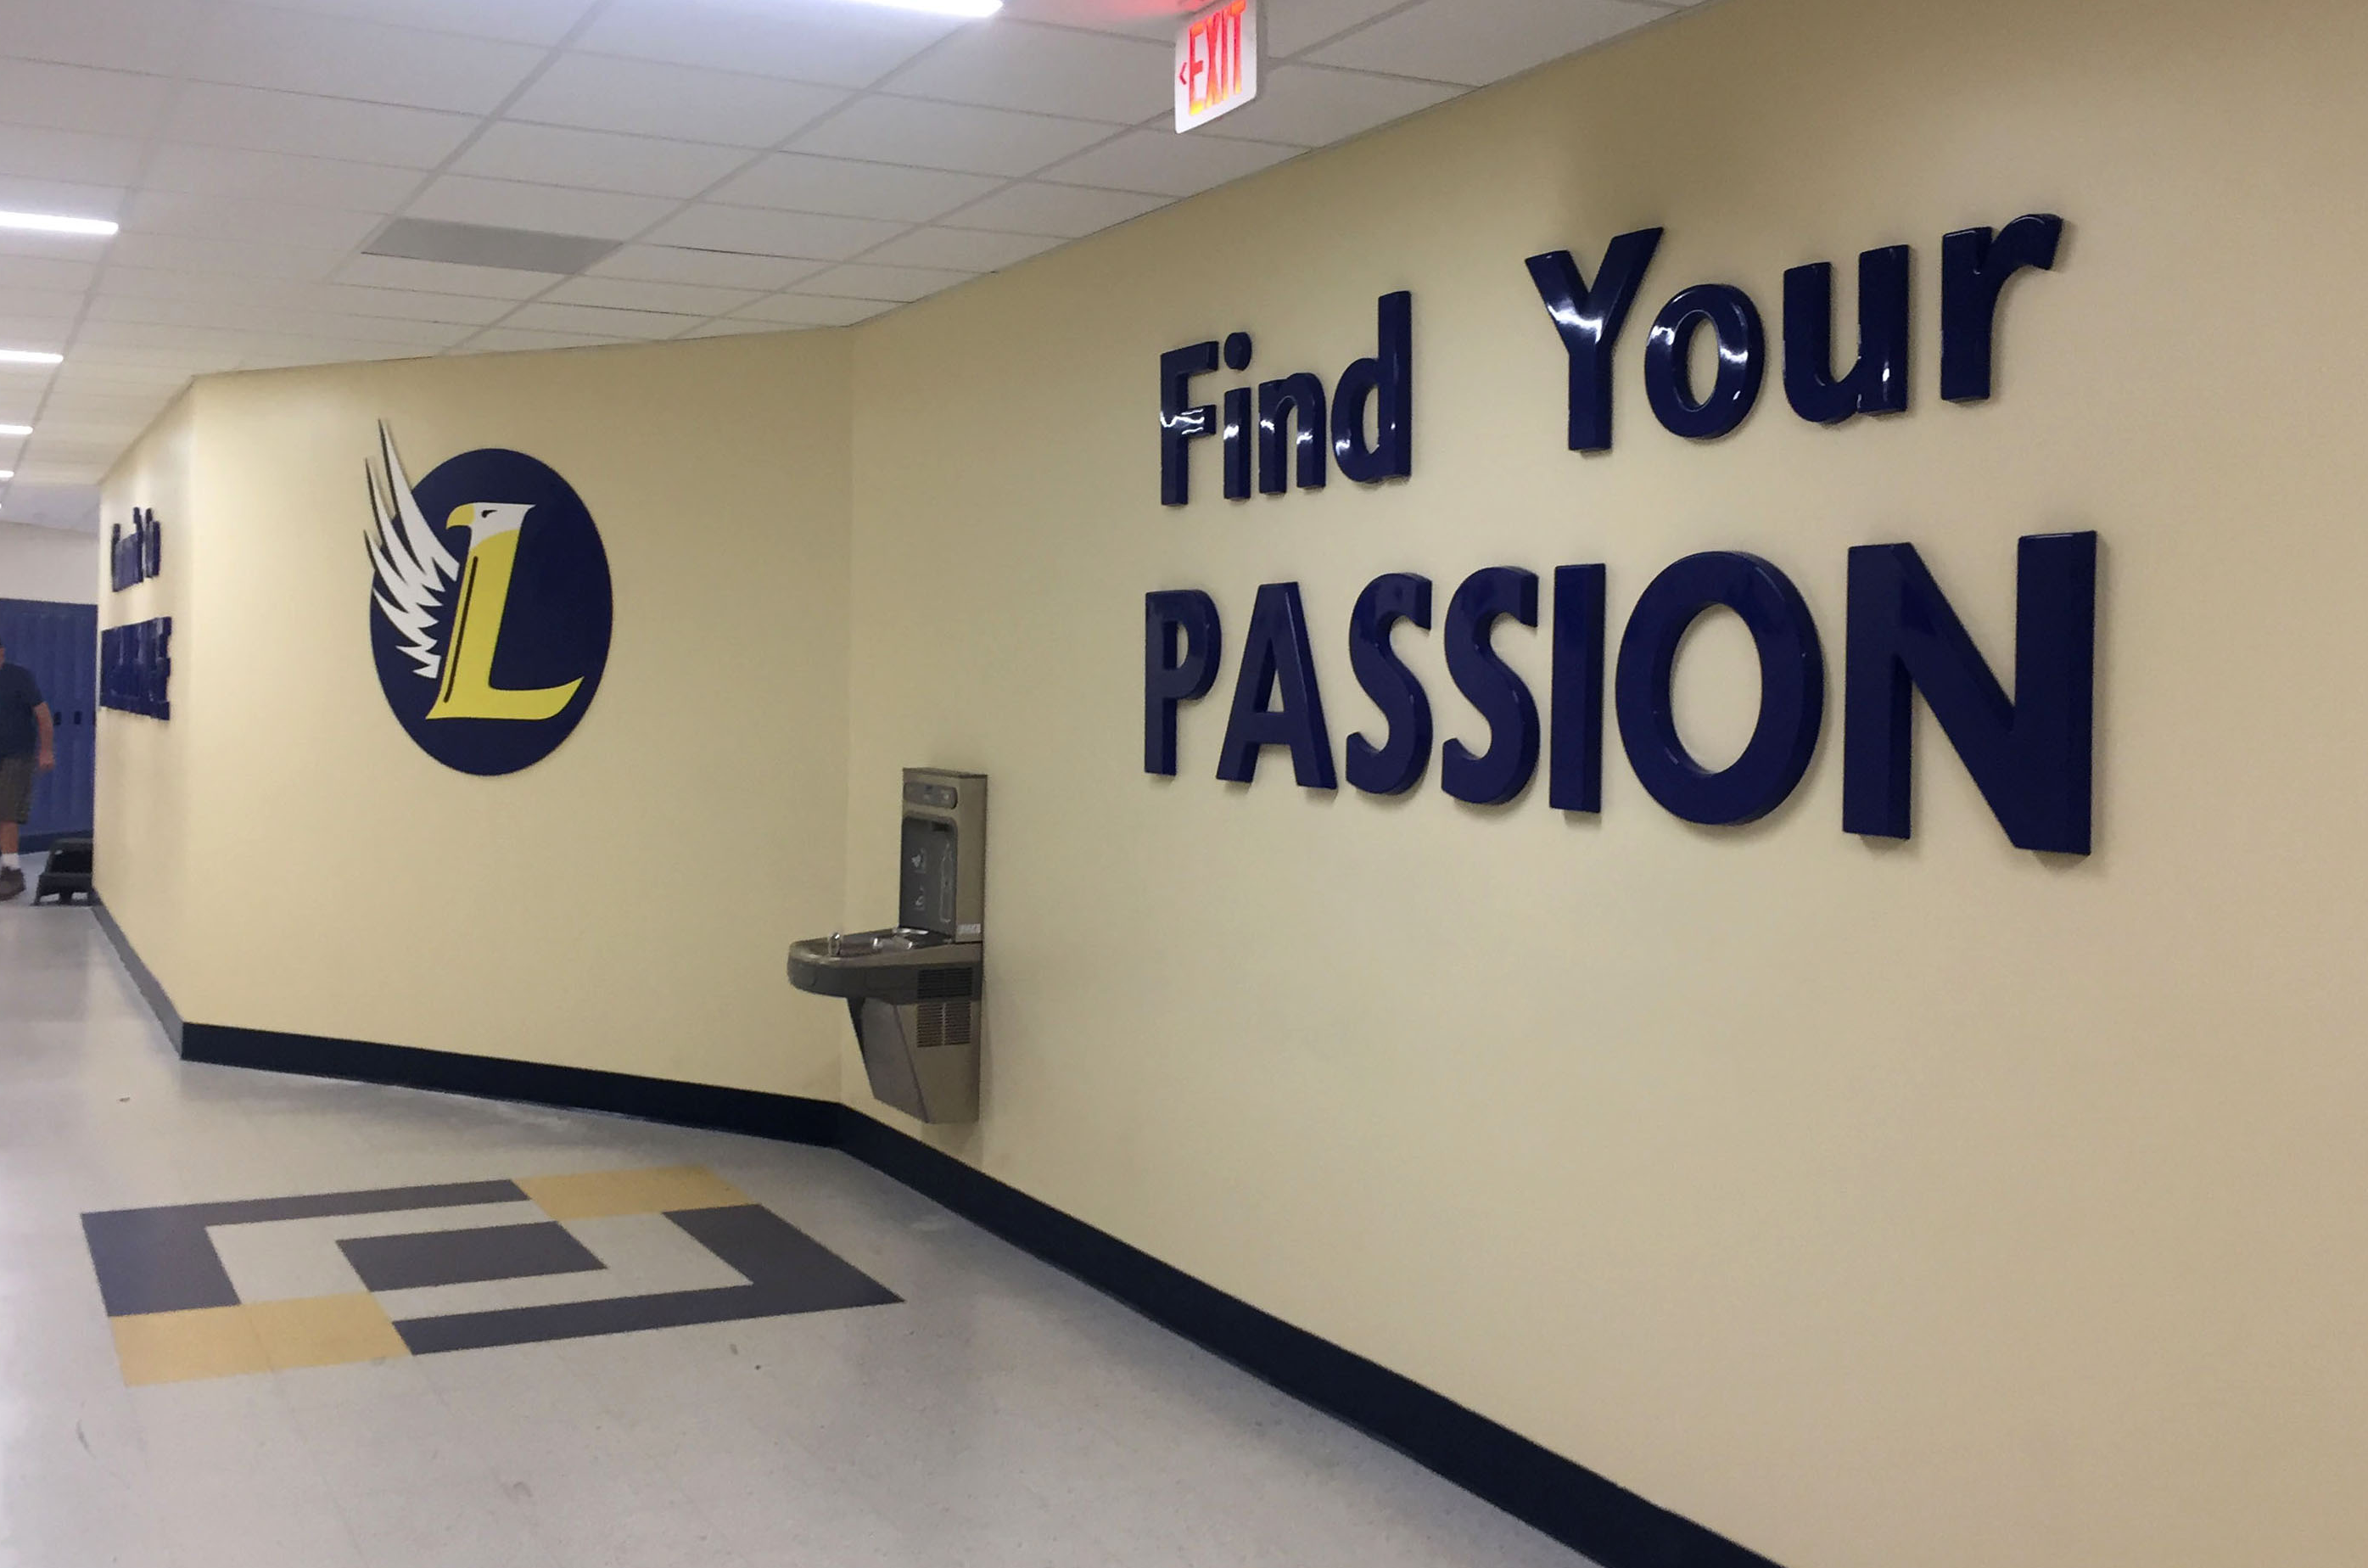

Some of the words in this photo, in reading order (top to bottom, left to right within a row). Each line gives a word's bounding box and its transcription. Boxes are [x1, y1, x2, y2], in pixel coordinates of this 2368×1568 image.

[1190, 0, 1246, 115] EXIT
[1160, 289, 1412, 507] Find
[1525, 213, 2063, 452] Your
[1144, 530, 2097, 855] PASSION
